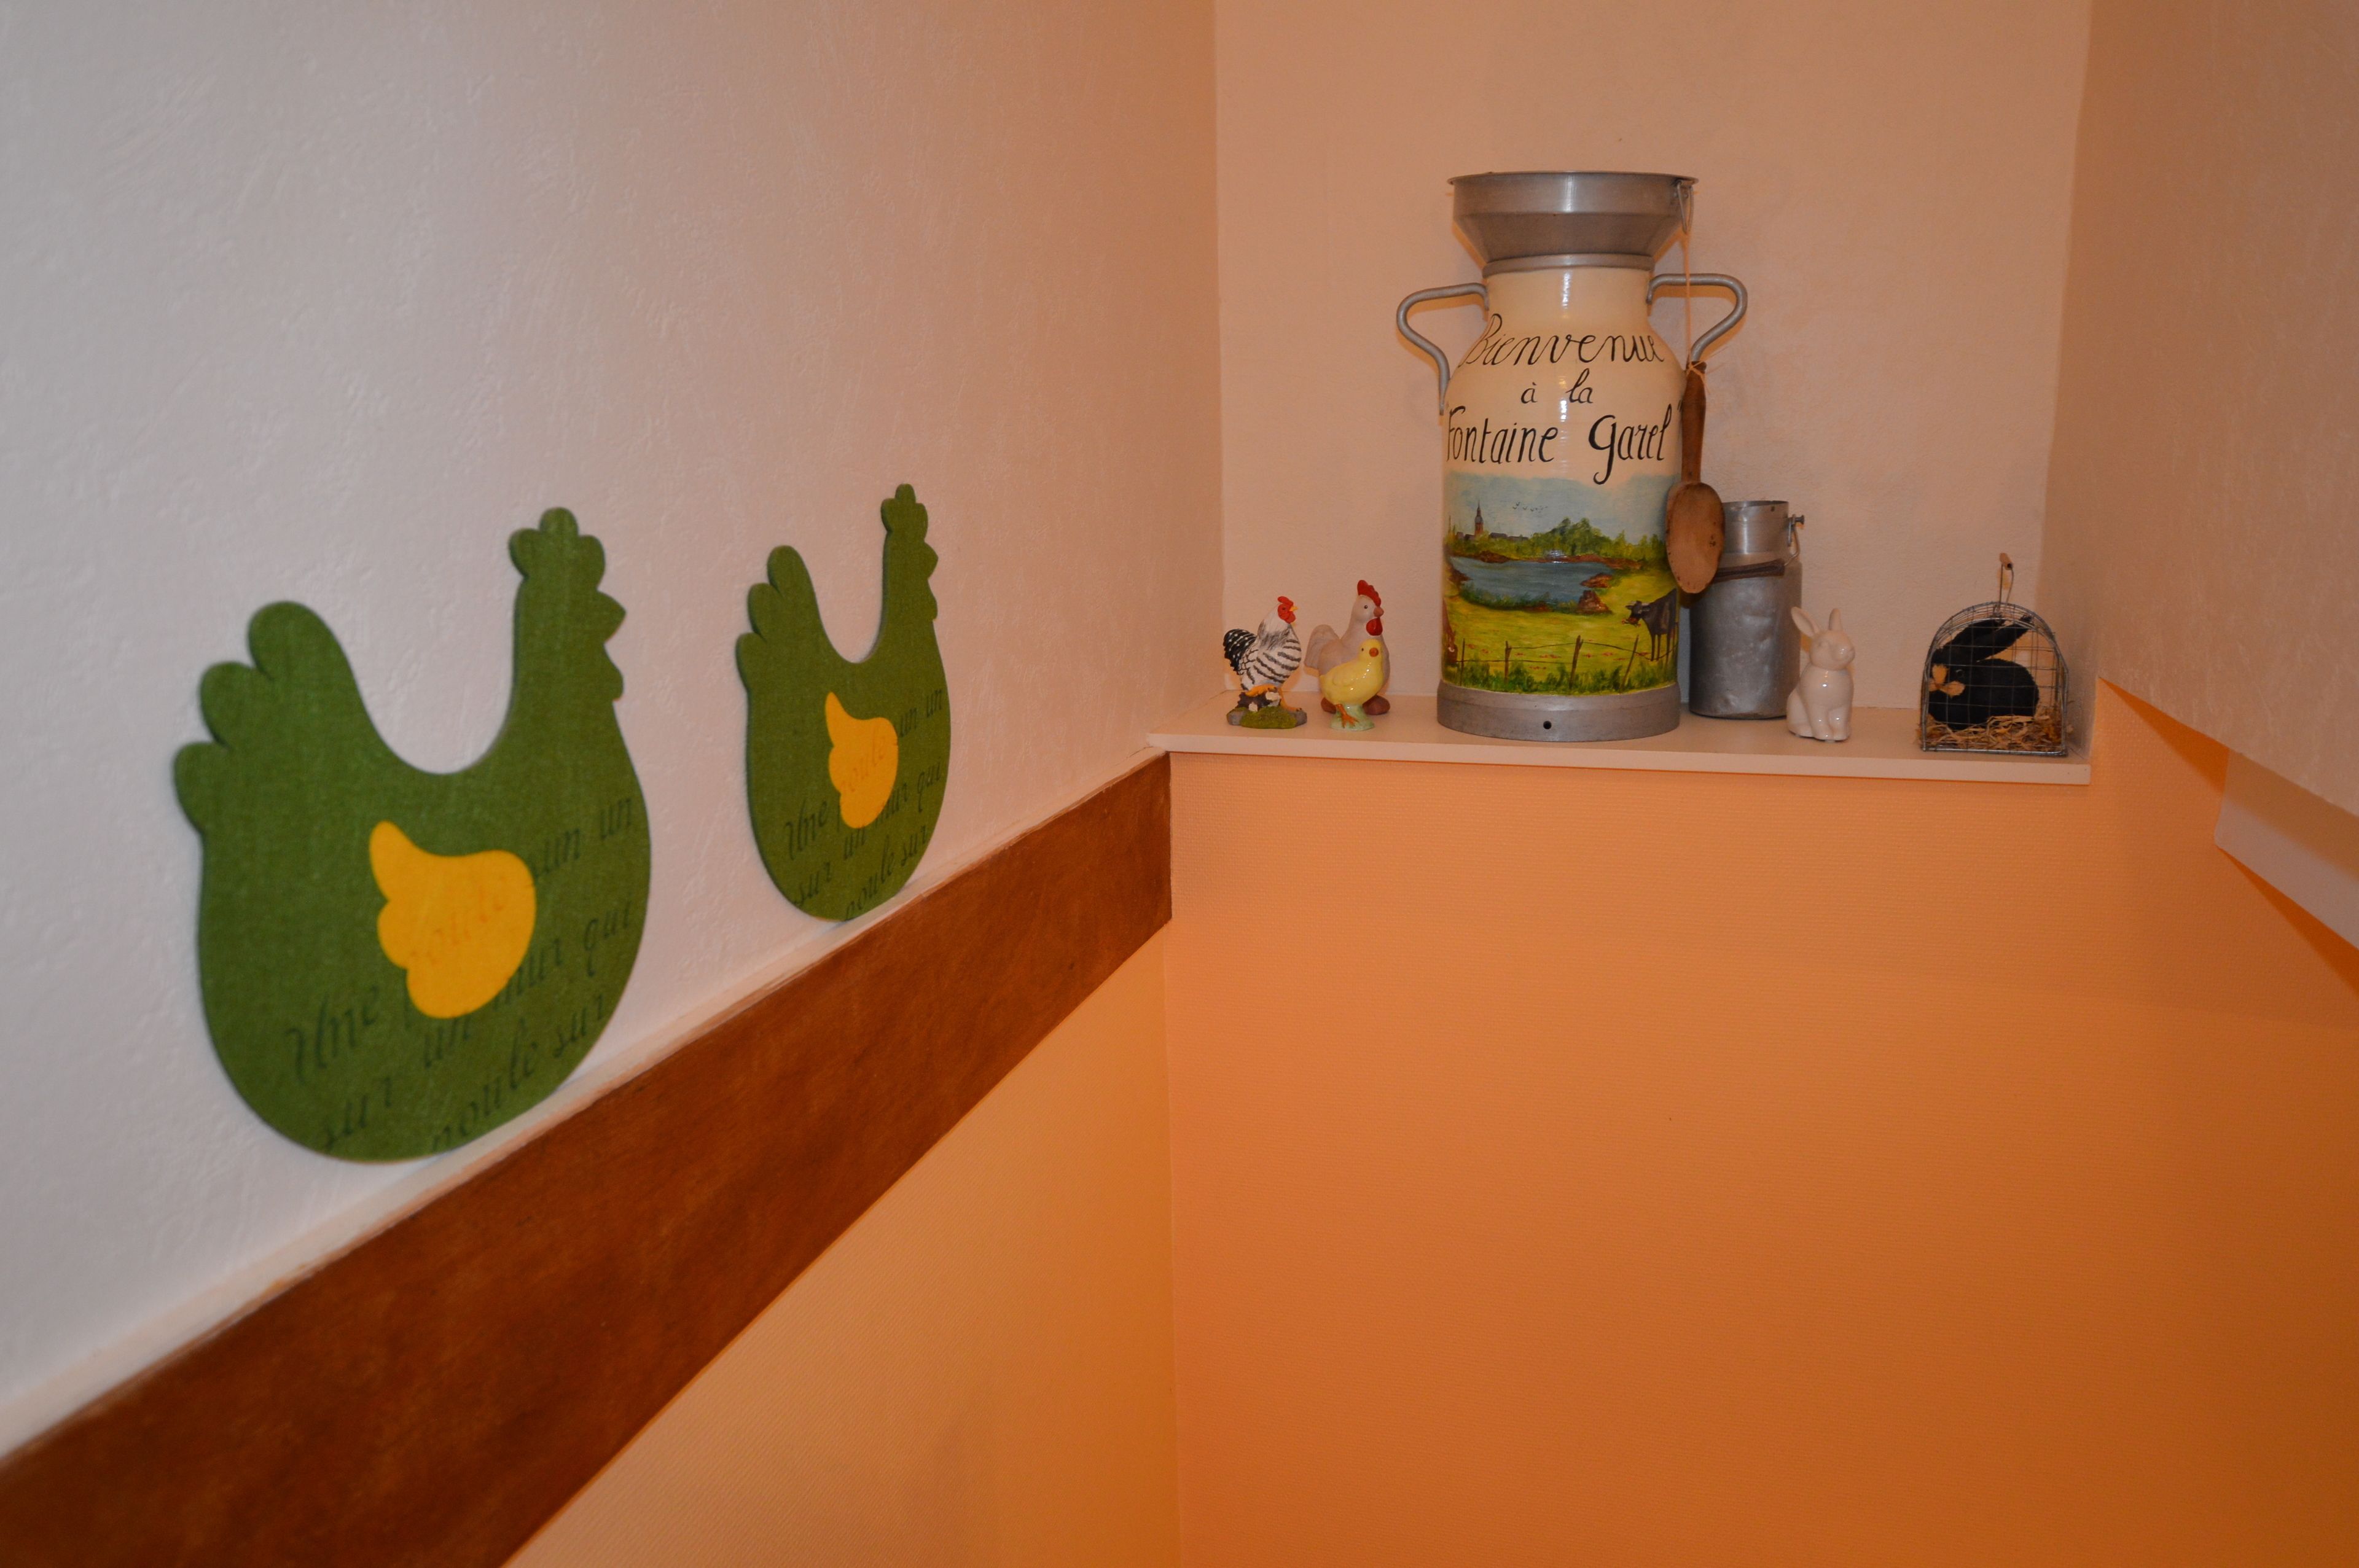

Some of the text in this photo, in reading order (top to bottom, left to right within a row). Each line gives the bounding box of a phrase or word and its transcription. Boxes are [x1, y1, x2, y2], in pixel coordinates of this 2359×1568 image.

[1457, 313, 1665, 367] Bienvenue
[1520, 368, 1594, 404] à la
